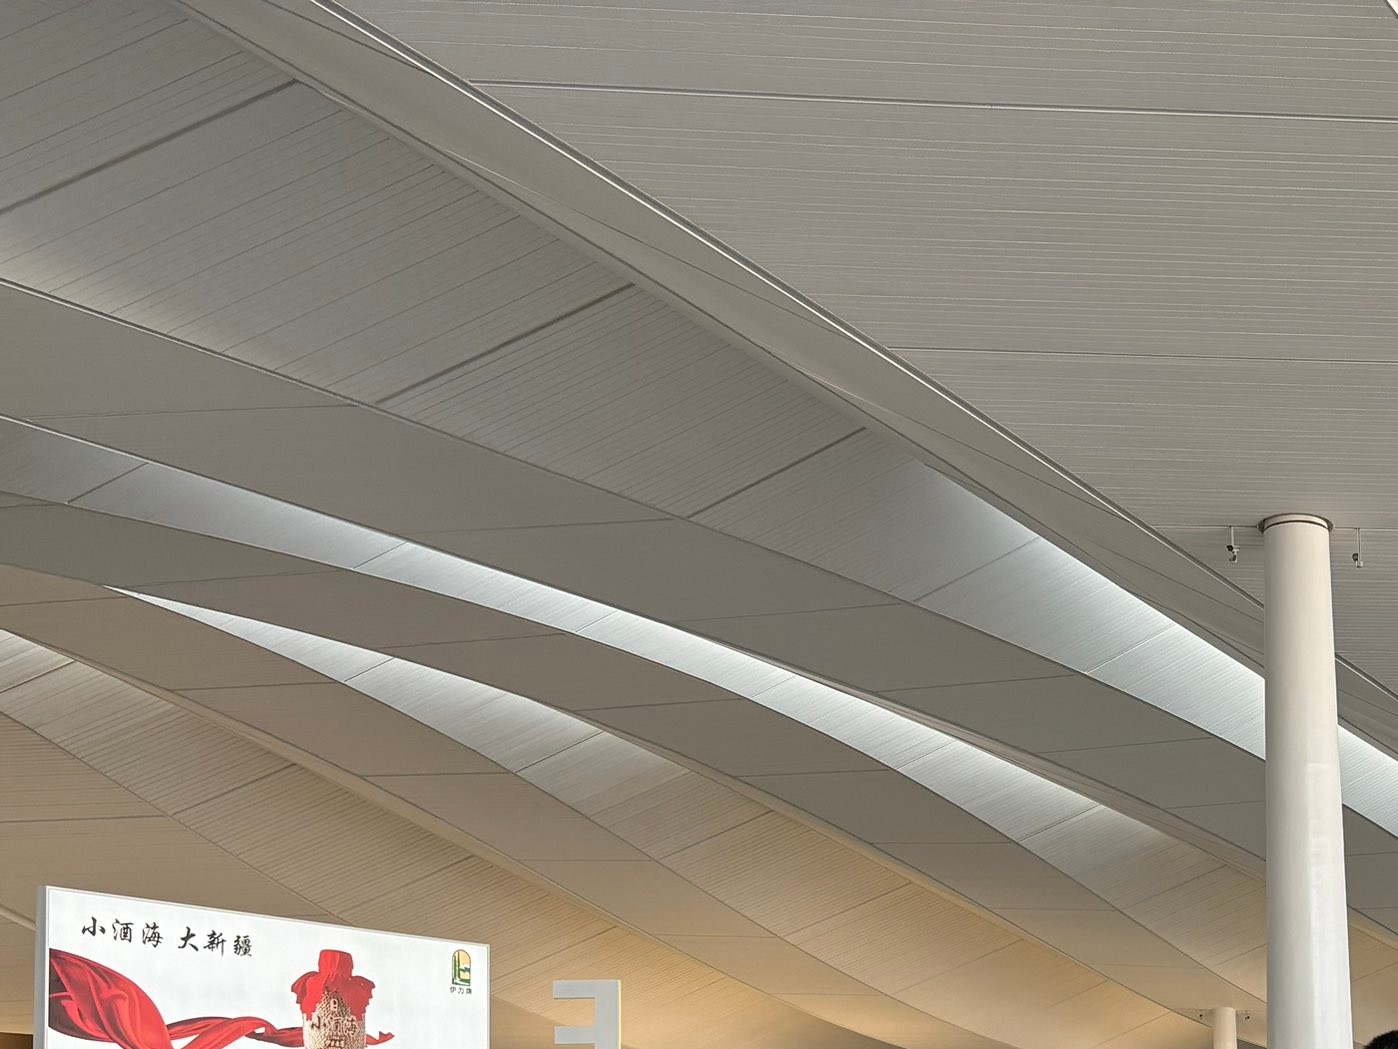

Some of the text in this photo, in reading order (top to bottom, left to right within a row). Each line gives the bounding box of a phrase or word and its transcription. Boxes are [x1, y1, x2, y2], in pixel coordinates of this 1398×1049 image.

[81, 916, 252, 957] 小酒海 大新疆
